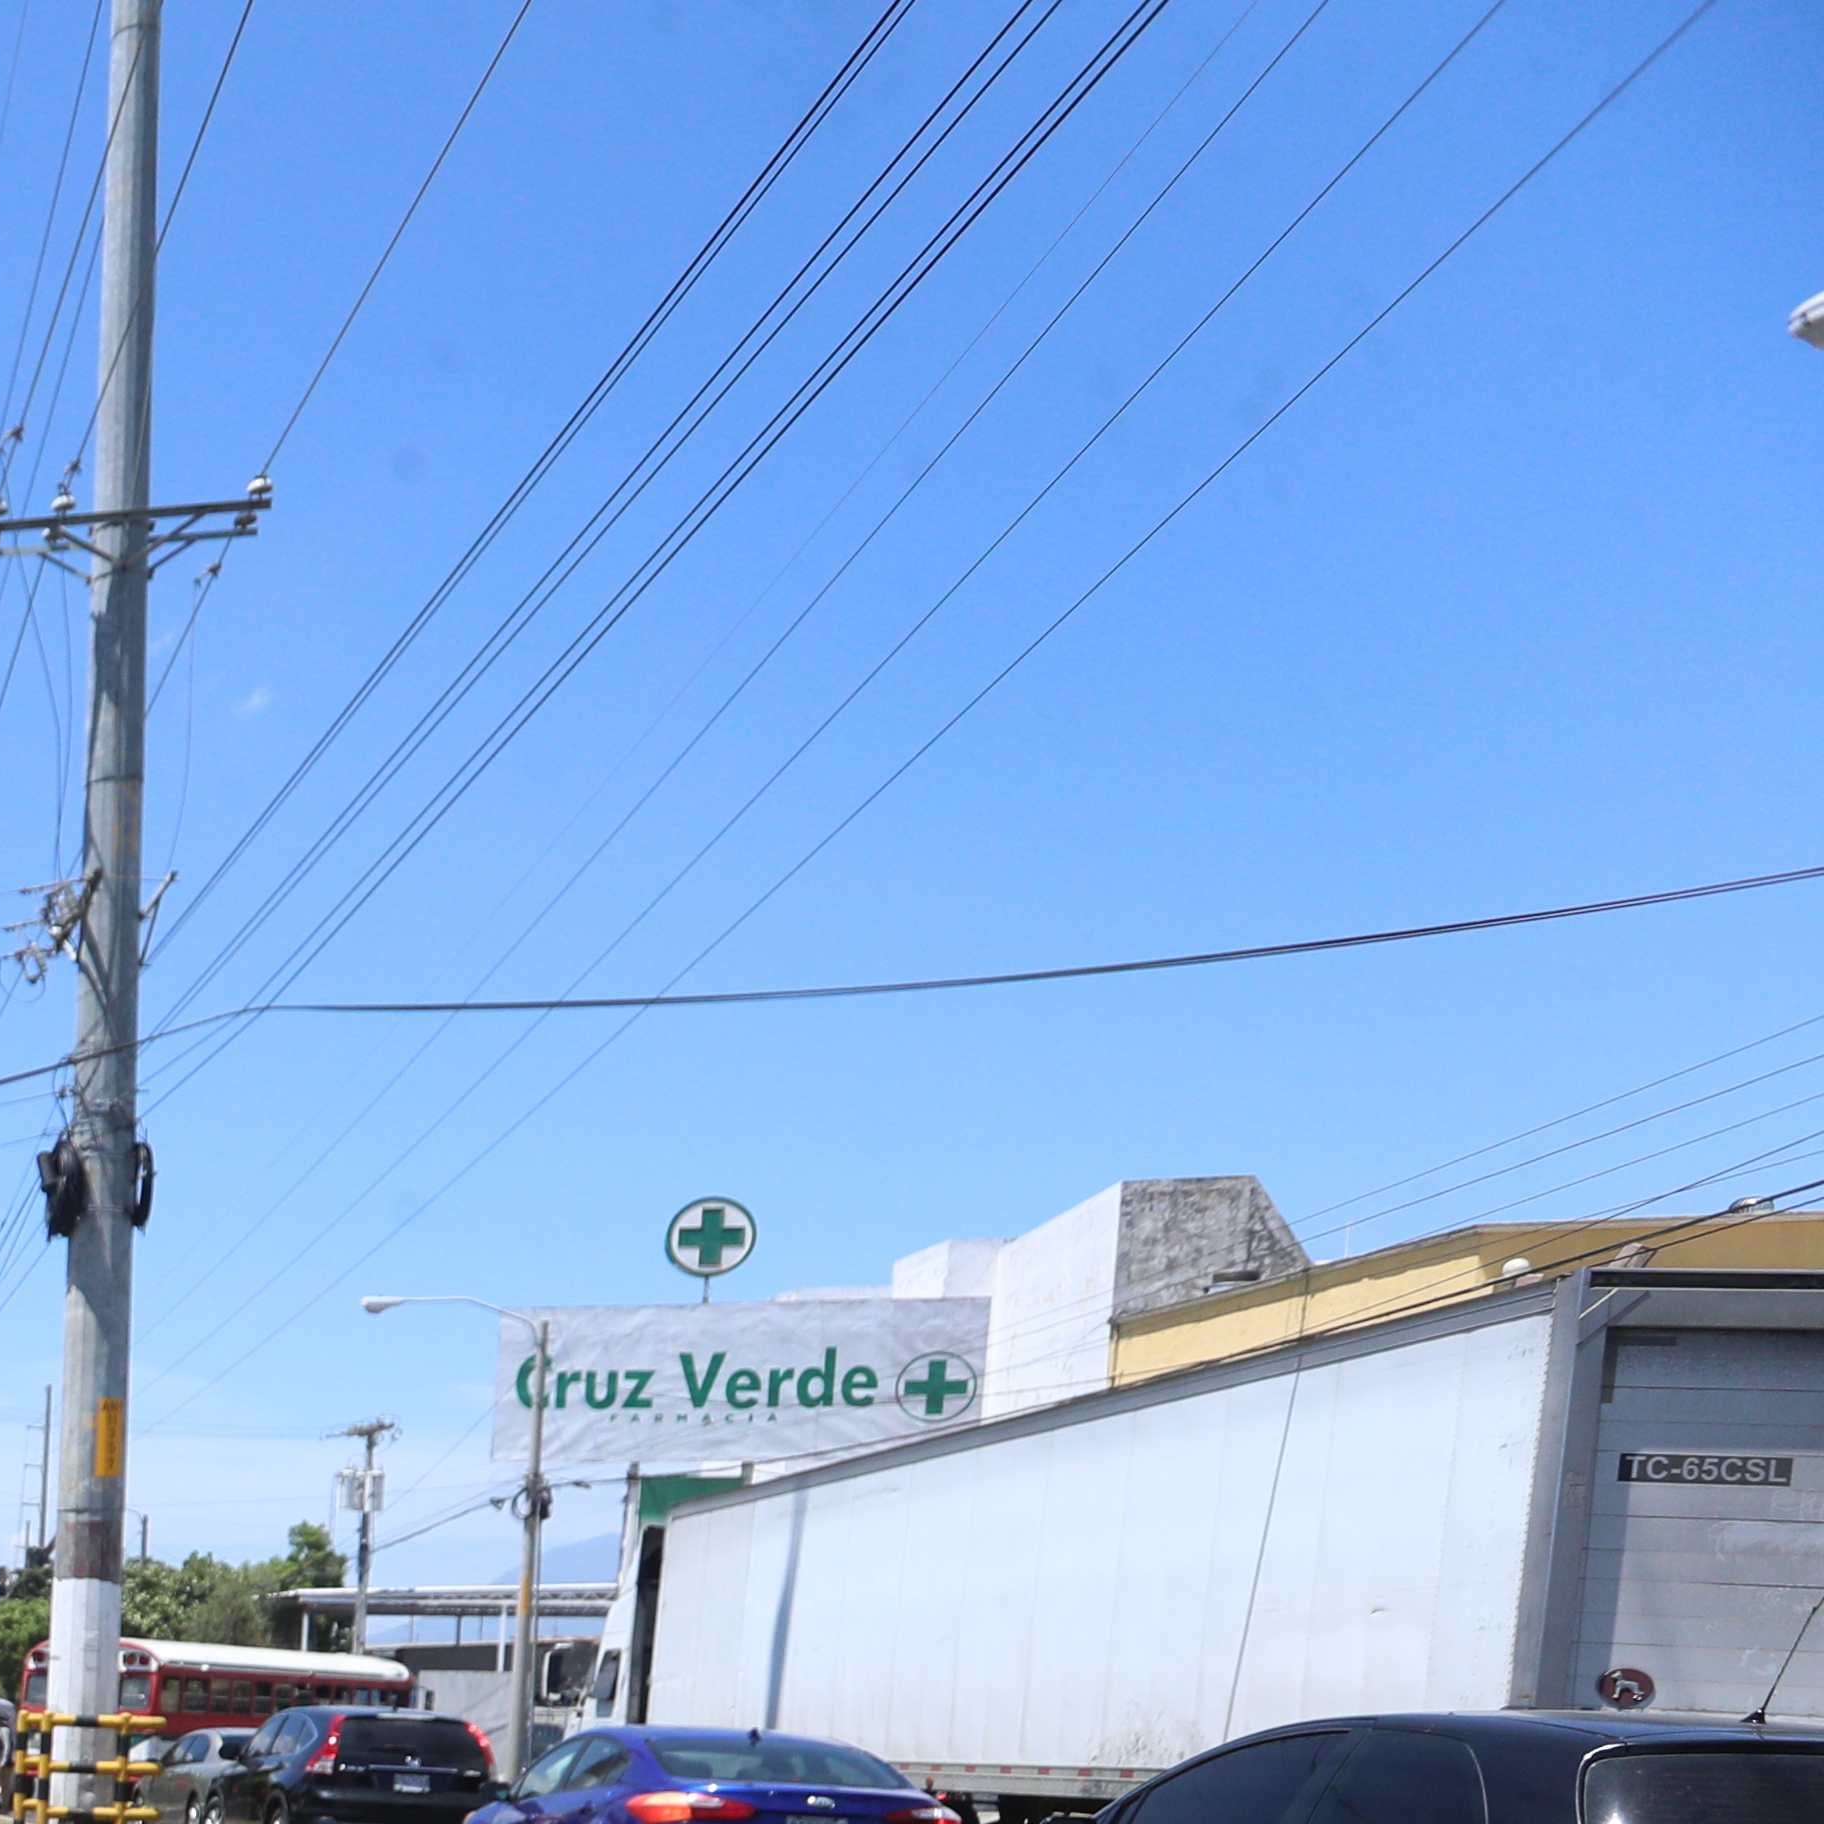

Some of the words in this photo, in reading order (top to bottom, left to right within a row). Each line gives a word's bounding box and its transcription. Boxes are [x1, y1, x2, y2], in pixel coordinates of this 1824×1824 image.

[516, 1354, 655, 1410] Cruz
[678, 1346, 878, 1410] Verde
[609, 1412, 779, 1423] FARMACIA
[1624, 1455, 1788, 1484] TC-65CSL
